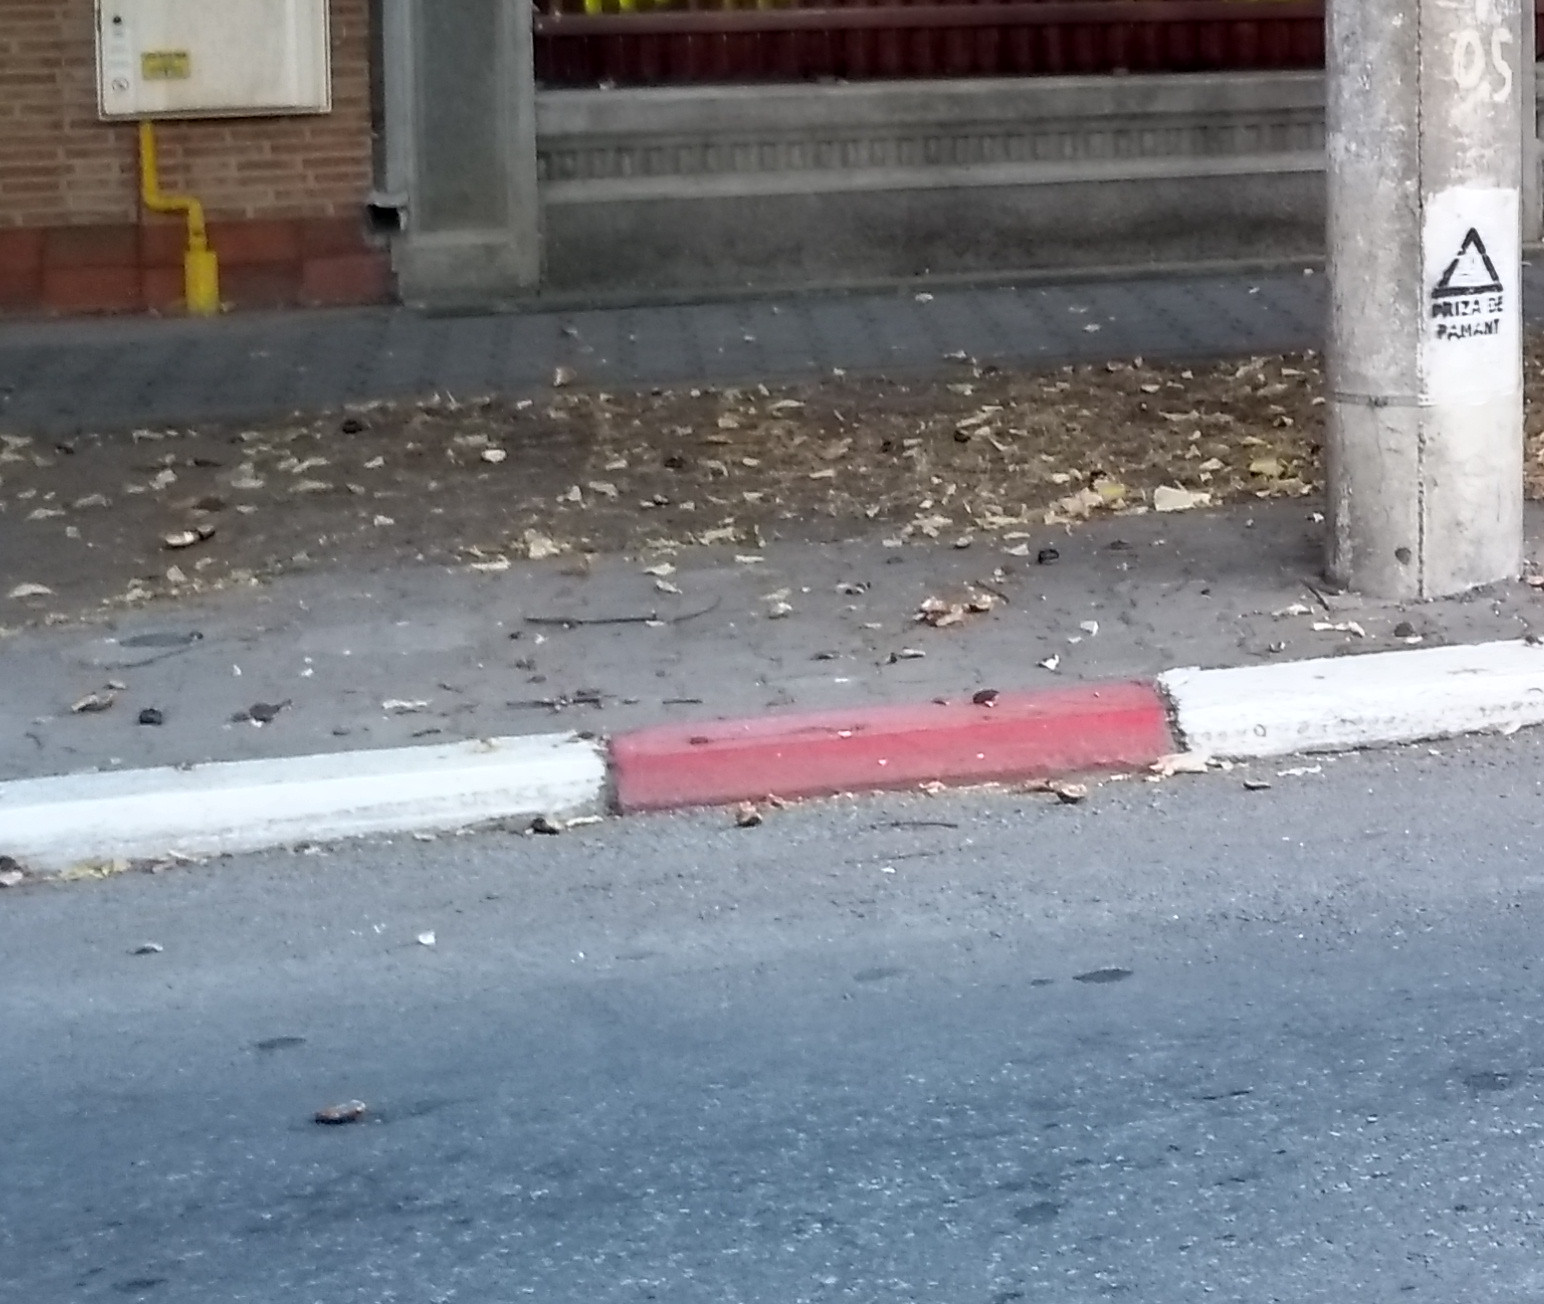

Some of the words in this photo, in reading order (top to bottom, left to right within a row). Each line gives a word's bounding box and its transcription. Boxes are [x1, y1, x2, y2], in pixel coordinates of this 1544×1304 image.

[1431, 300, 1481, 318] PRIZA
[1488, 295, 1503, 313] DE
[1436, 318, 1500, 341] PAMANT
